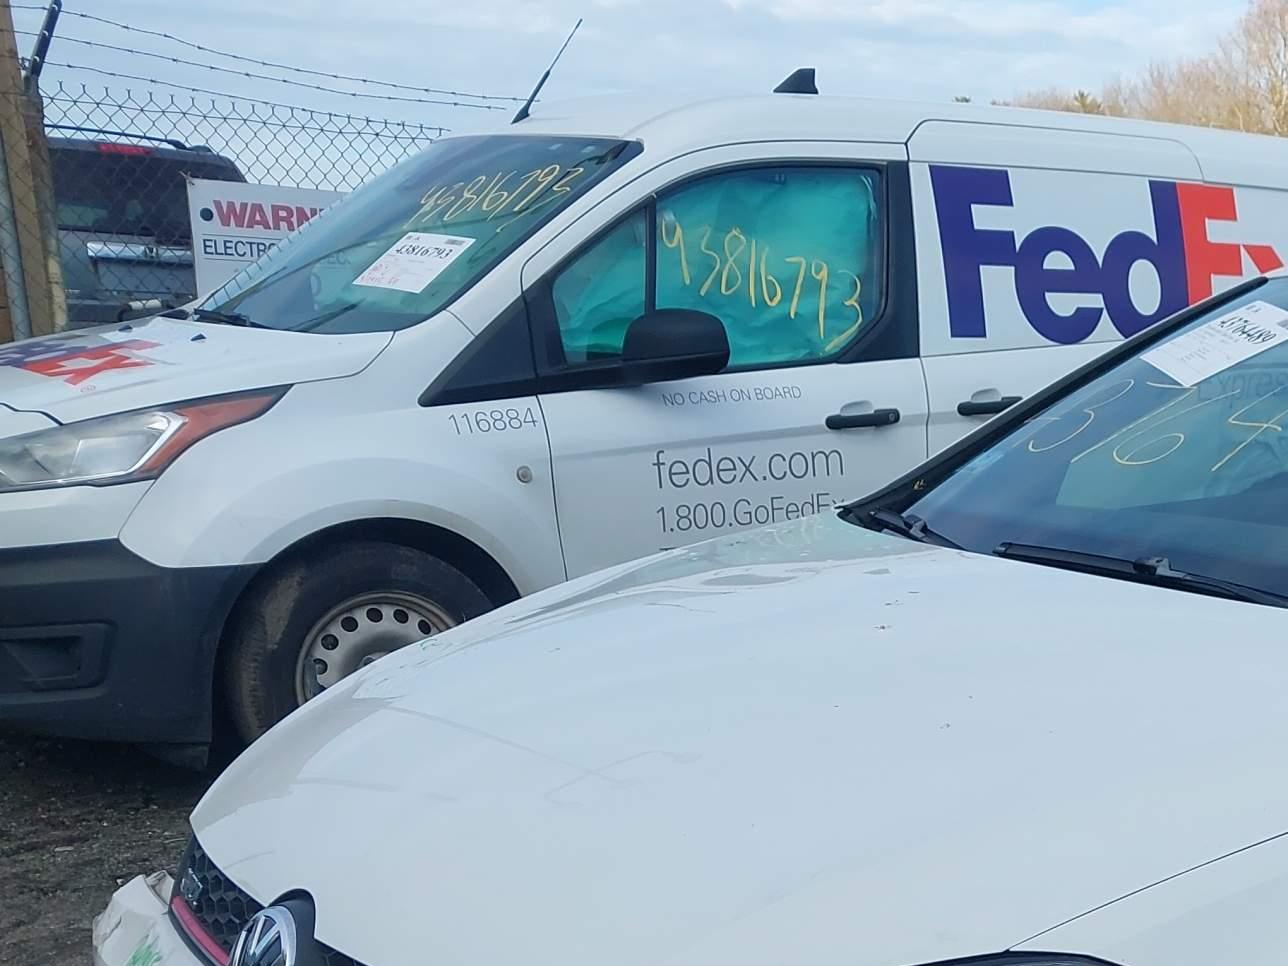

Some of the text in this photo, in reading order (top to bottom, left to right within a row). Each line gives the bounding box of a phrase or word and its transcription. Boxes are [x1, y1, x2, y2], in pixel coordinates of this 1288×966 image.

[212, 199, 325, 232] WARN
[661, 385, 802, 407] NO CASH ON BOARD
[448, 407, 538, 435] 116884
[652, 447, 844, 489] fedex.com
